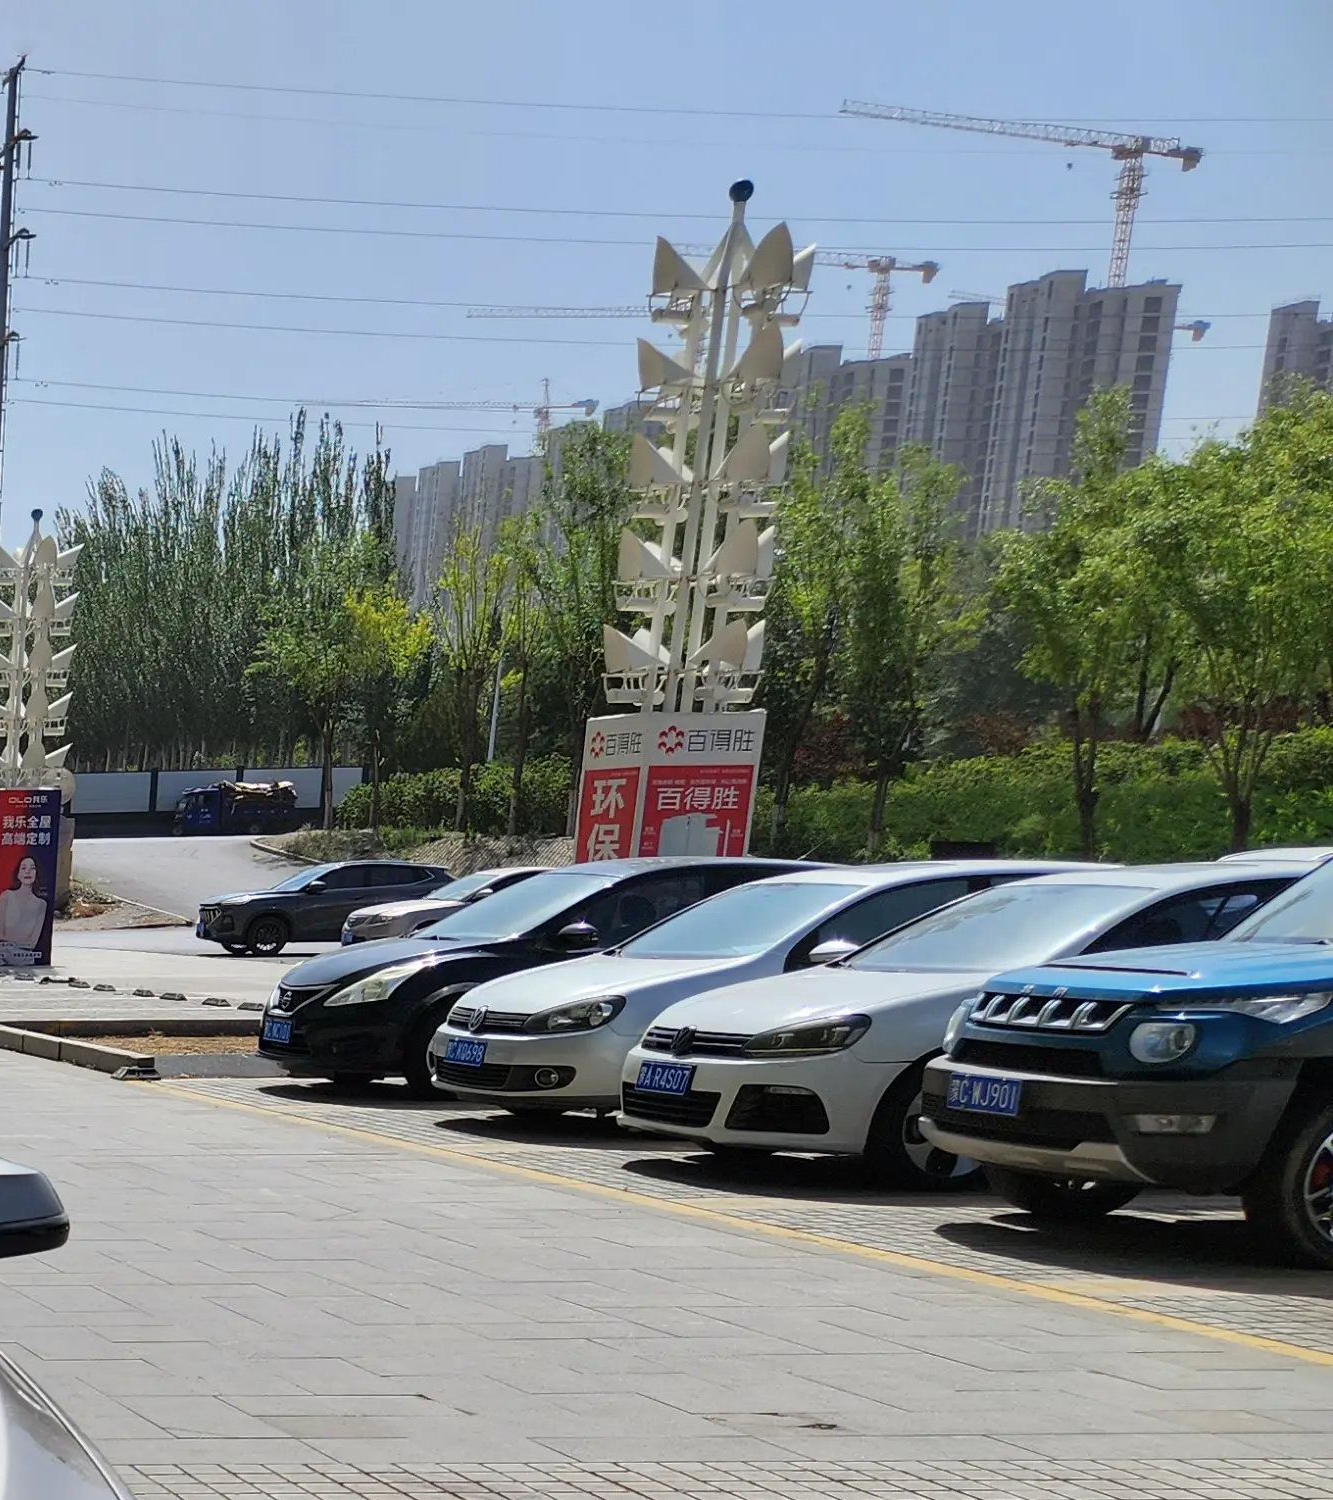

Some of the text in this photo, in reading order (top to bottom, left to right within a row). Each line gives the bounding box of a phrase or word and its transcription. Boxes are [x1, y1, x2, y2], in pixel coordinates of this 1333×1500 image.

[605, 731, 642, 756] 百得胜
[687, 728, 755, 752] 百得胜
[656, 786, 740, 811] 百得胜
[2, 815, 52, 829] 我乐全屋
[0, 832, 51, 846] 高端定制
